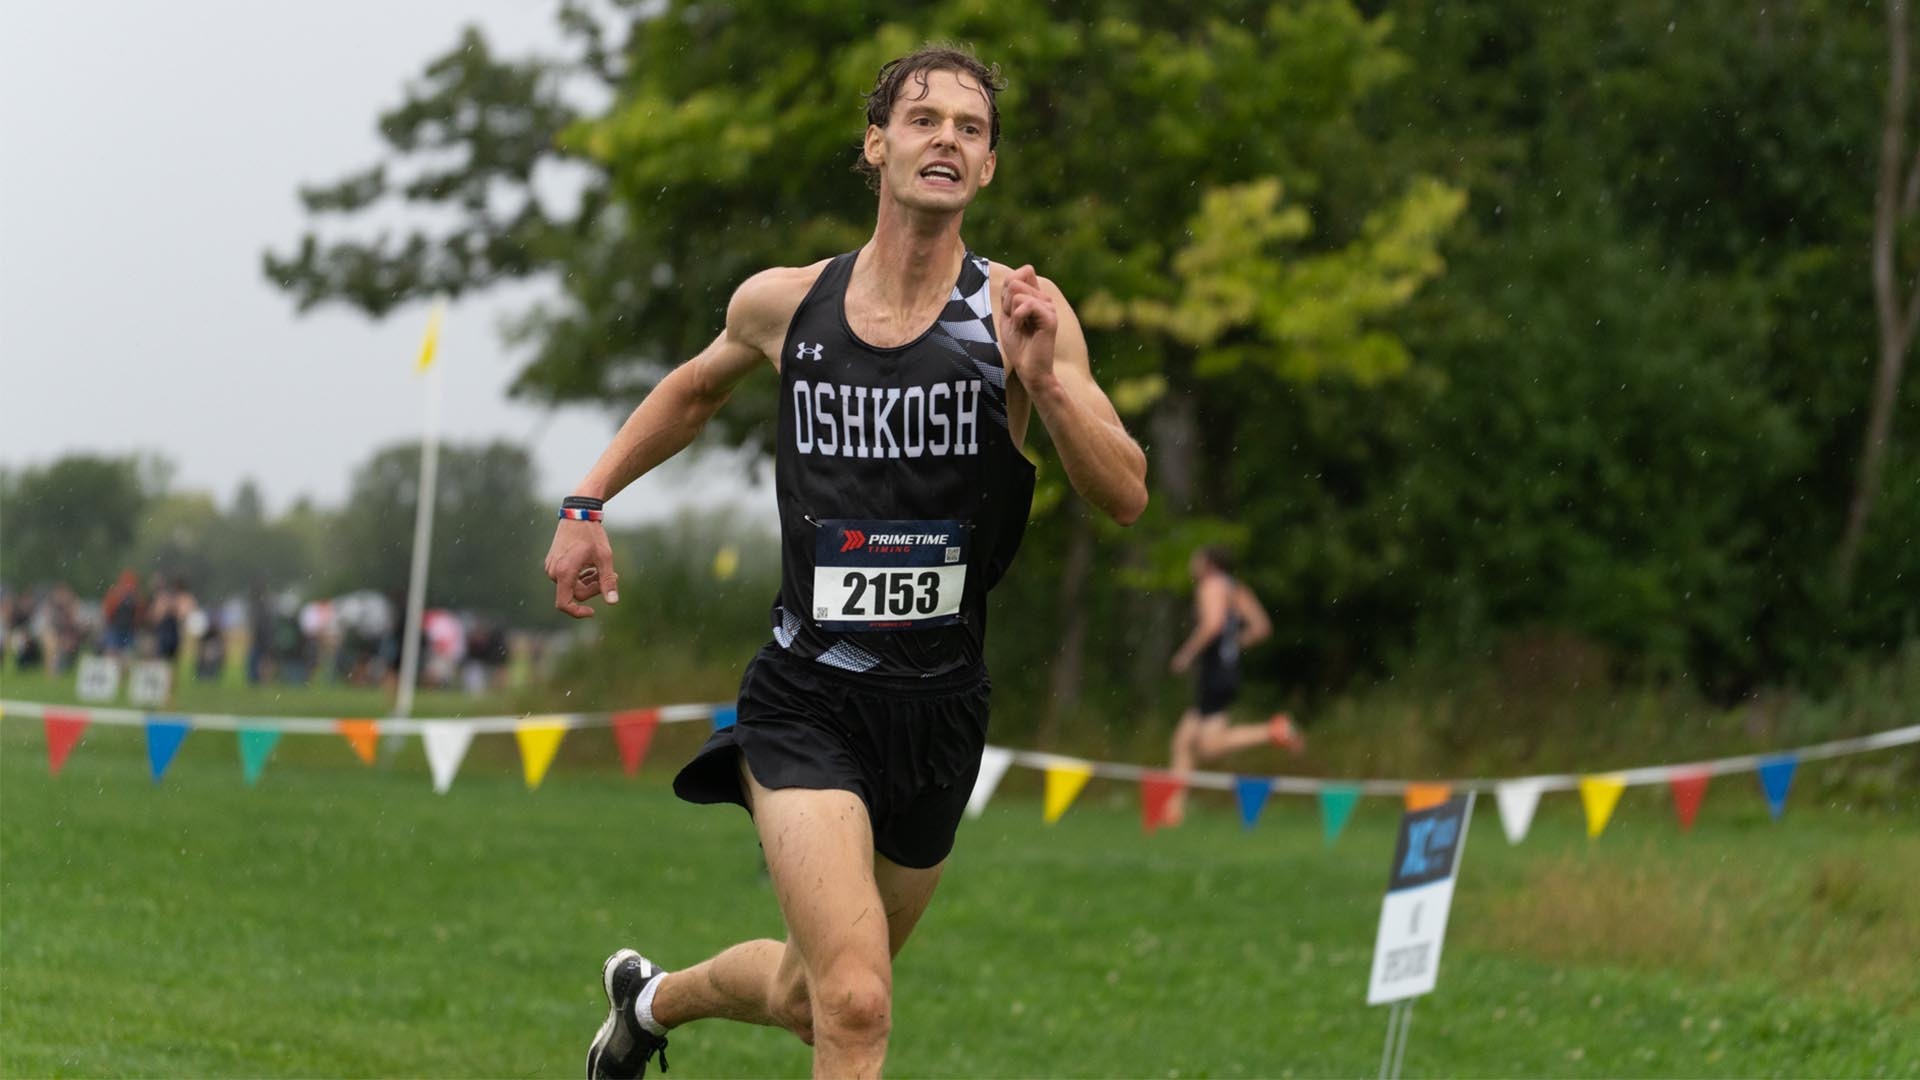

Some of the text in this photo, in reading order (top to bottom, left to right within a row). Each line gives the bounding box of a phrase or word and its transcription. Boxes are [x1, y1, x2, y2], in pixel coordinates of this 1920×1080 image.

[793, 380, 981, 458] OSHKOSH
[868, 534, 949, 545] PRIMETIME
[842, 572, 940, 615] 2153
